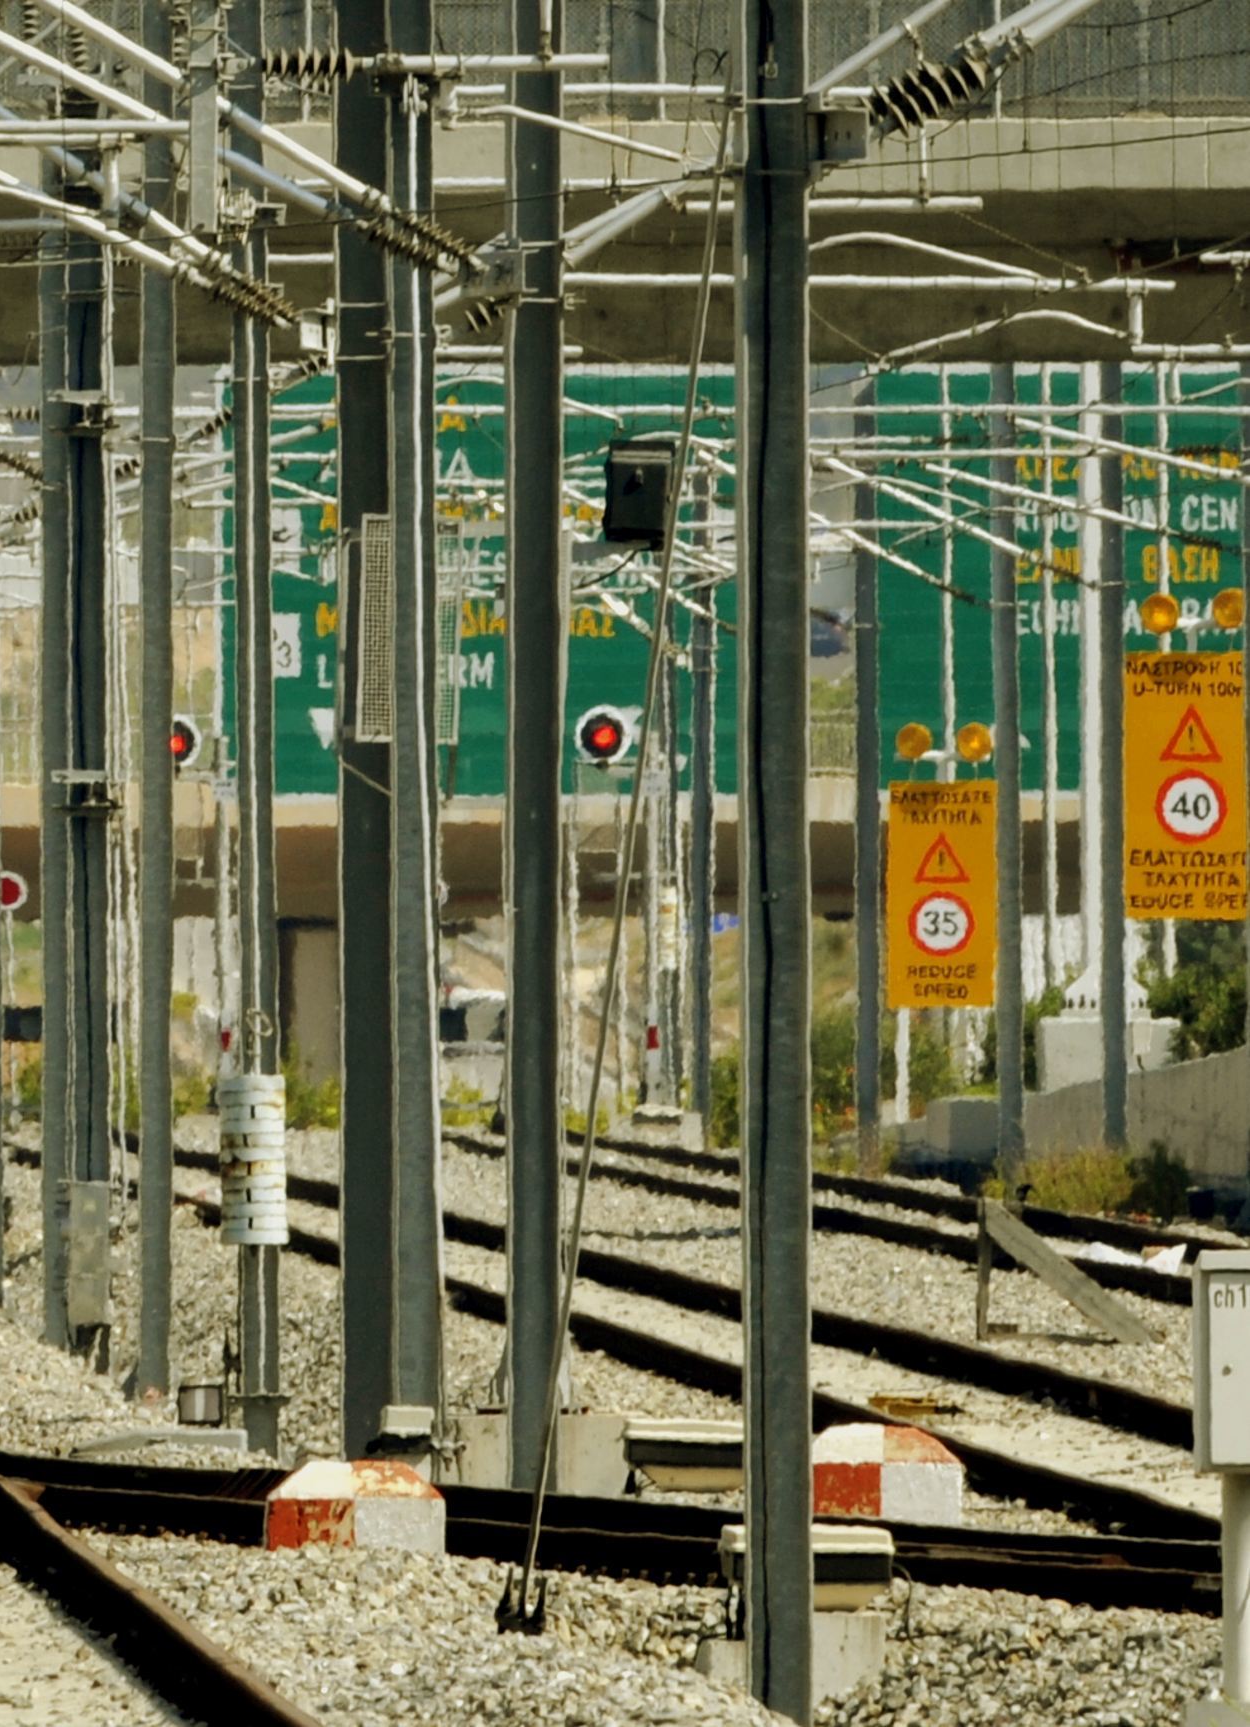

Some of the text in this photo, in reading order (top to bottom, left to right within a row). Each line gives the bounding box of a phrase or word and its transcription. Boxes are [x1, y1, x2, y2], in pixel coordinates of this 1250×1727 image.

[1181, 494, 1238, 532] CEN
[1133, 681, 1201, 697] U-TURN
[1171, 792, 1211, 820] 40
[1130, 893, 1194, 909] EDUCE
[923, 911, 958, 937] 35
[907, 964, 976, 980] REDUCE
